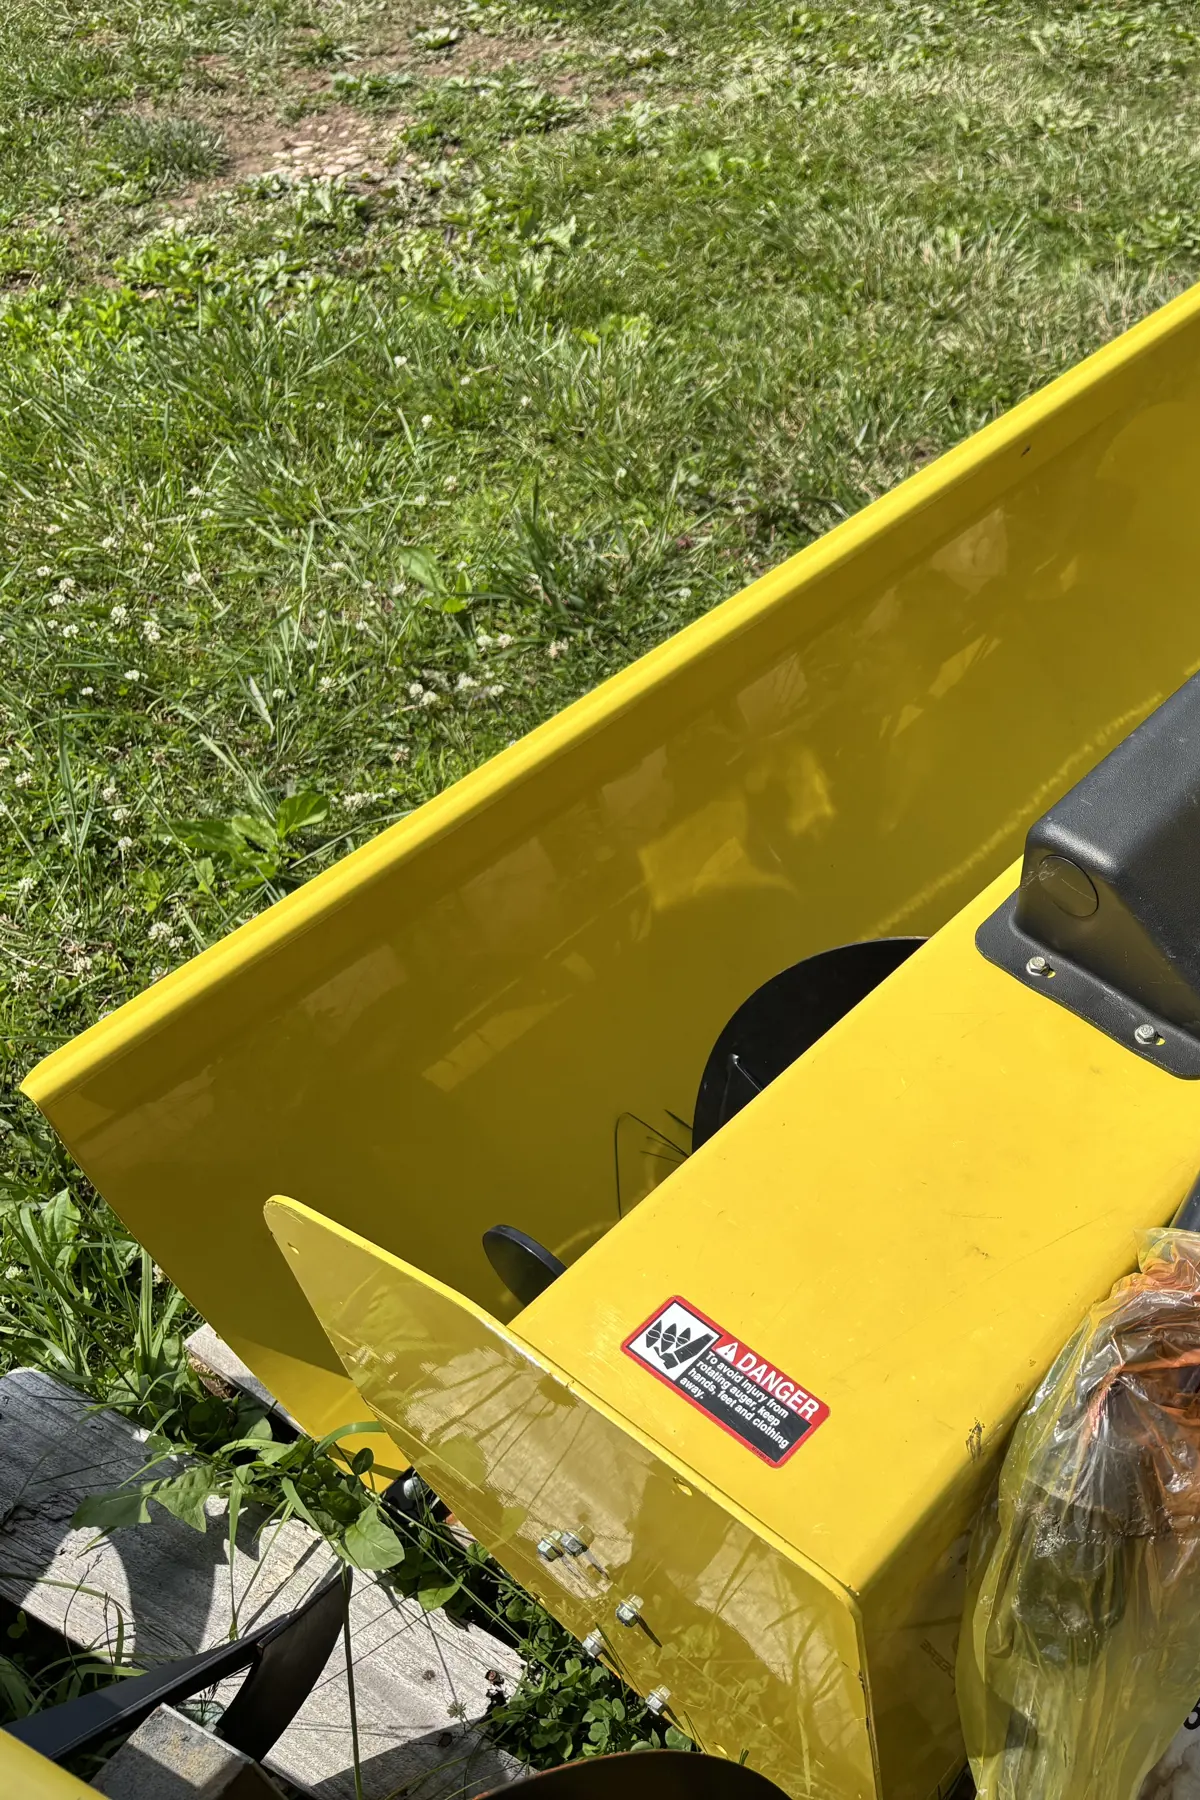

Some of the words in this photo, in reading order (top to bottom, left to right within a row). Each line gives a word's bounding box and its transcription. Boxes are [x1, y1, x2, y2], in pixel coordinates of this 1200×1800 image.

[679, 1375, 705, 1400] away.
[687, 1368, 717, 1396] hands,
[717, 1390, 737, 1410] feet
[734, 1403, 754, 1422] and
[752, 1416, 790, 1450] clothing
[696, 1360, 731, 1391] rotating
[729, 1385, 757, 1414] auger,
[757, 1405, 781, 1427] keep
[706, 1351, 718, 1365] To
[716, 1361, 742, 1384] avoid
[742, 1379, 769, 1405] injury
[765, 1397, 789, 1420] from
[735, 1352, 820, 1420] DANGER
